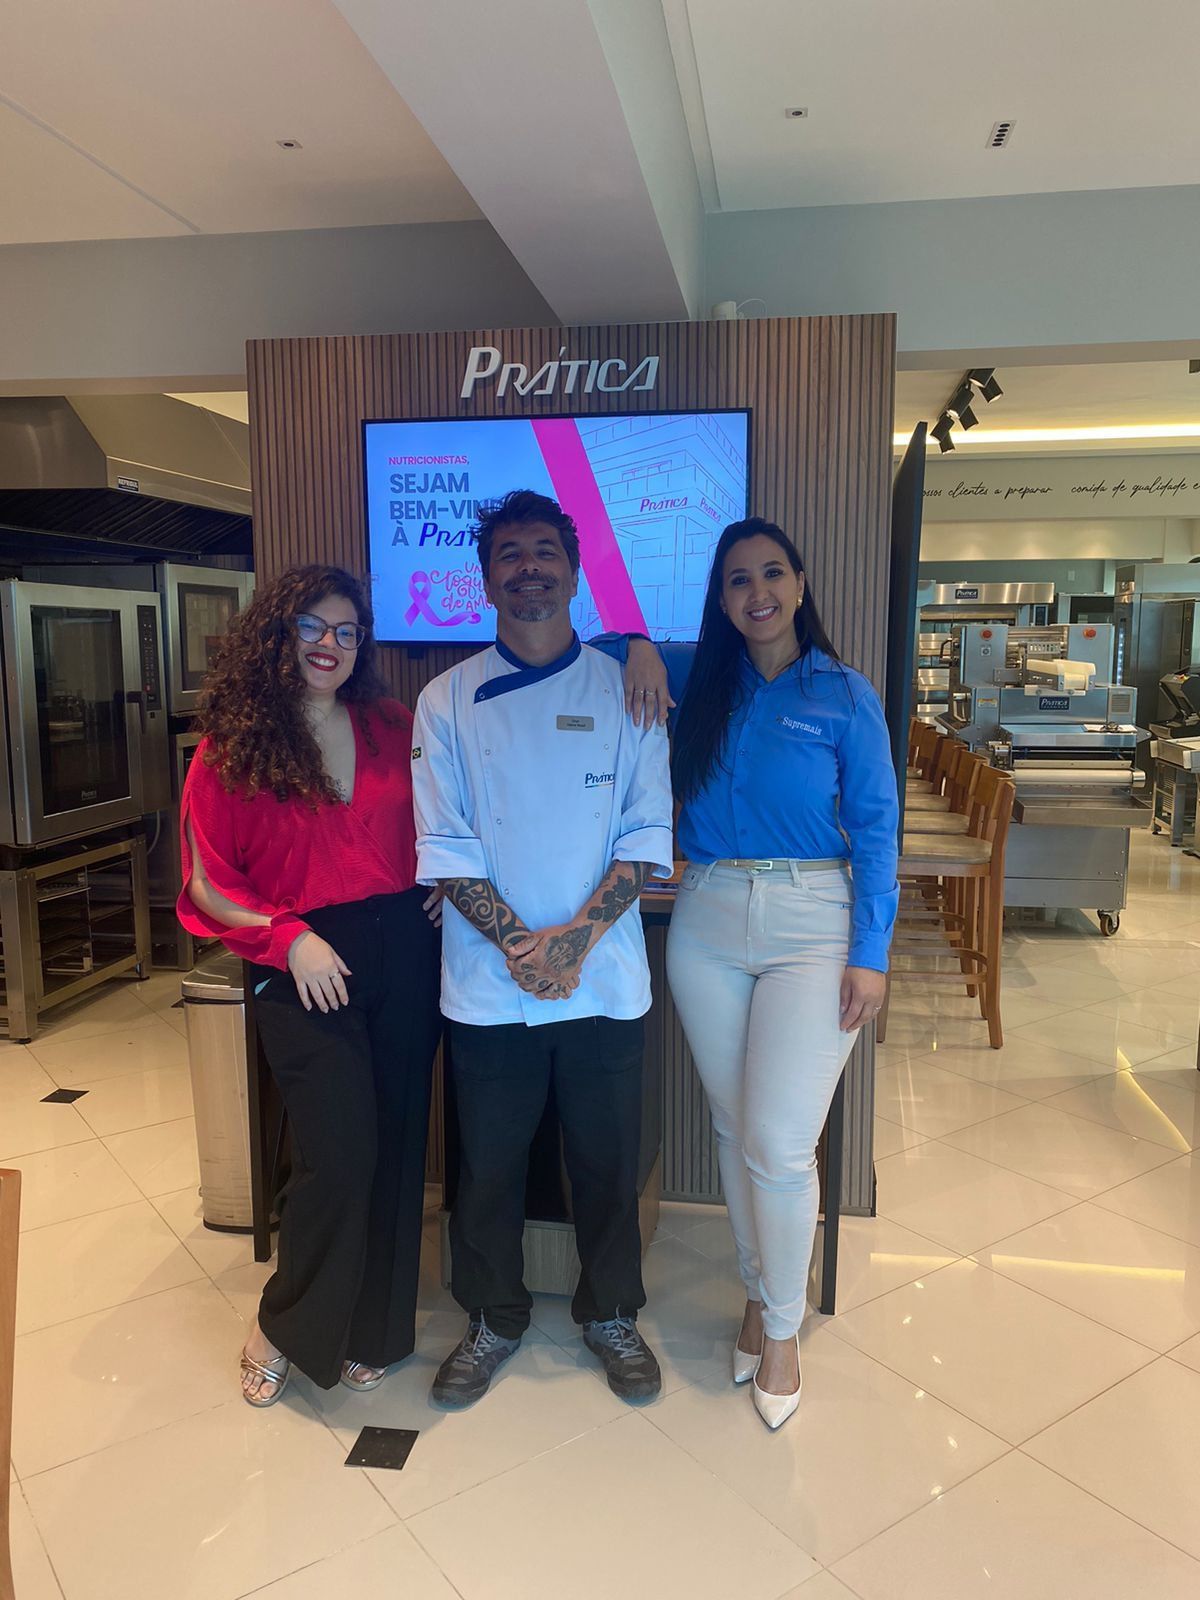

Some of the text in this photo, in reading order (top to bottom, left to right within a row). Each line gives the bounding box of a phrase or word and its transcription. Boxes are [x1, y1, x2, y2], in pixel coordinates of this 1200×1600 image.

[388, 455, 470, 465] NUTRICIONISTAS,
[390, 472, 470, 494] SEJAM
[922, 488, 942, 497] ossos
[948, 481, 988, 498] clientes
[1004, 486, 1053, 500] preparar
[1071, 479, 1107, 499] comida
[1112, 479, 1127, 498] de
[1129, 476, 1188, 498] qualidade
[391, 520, 410, 547] À
[782, 716, 823, 736] Supremais
